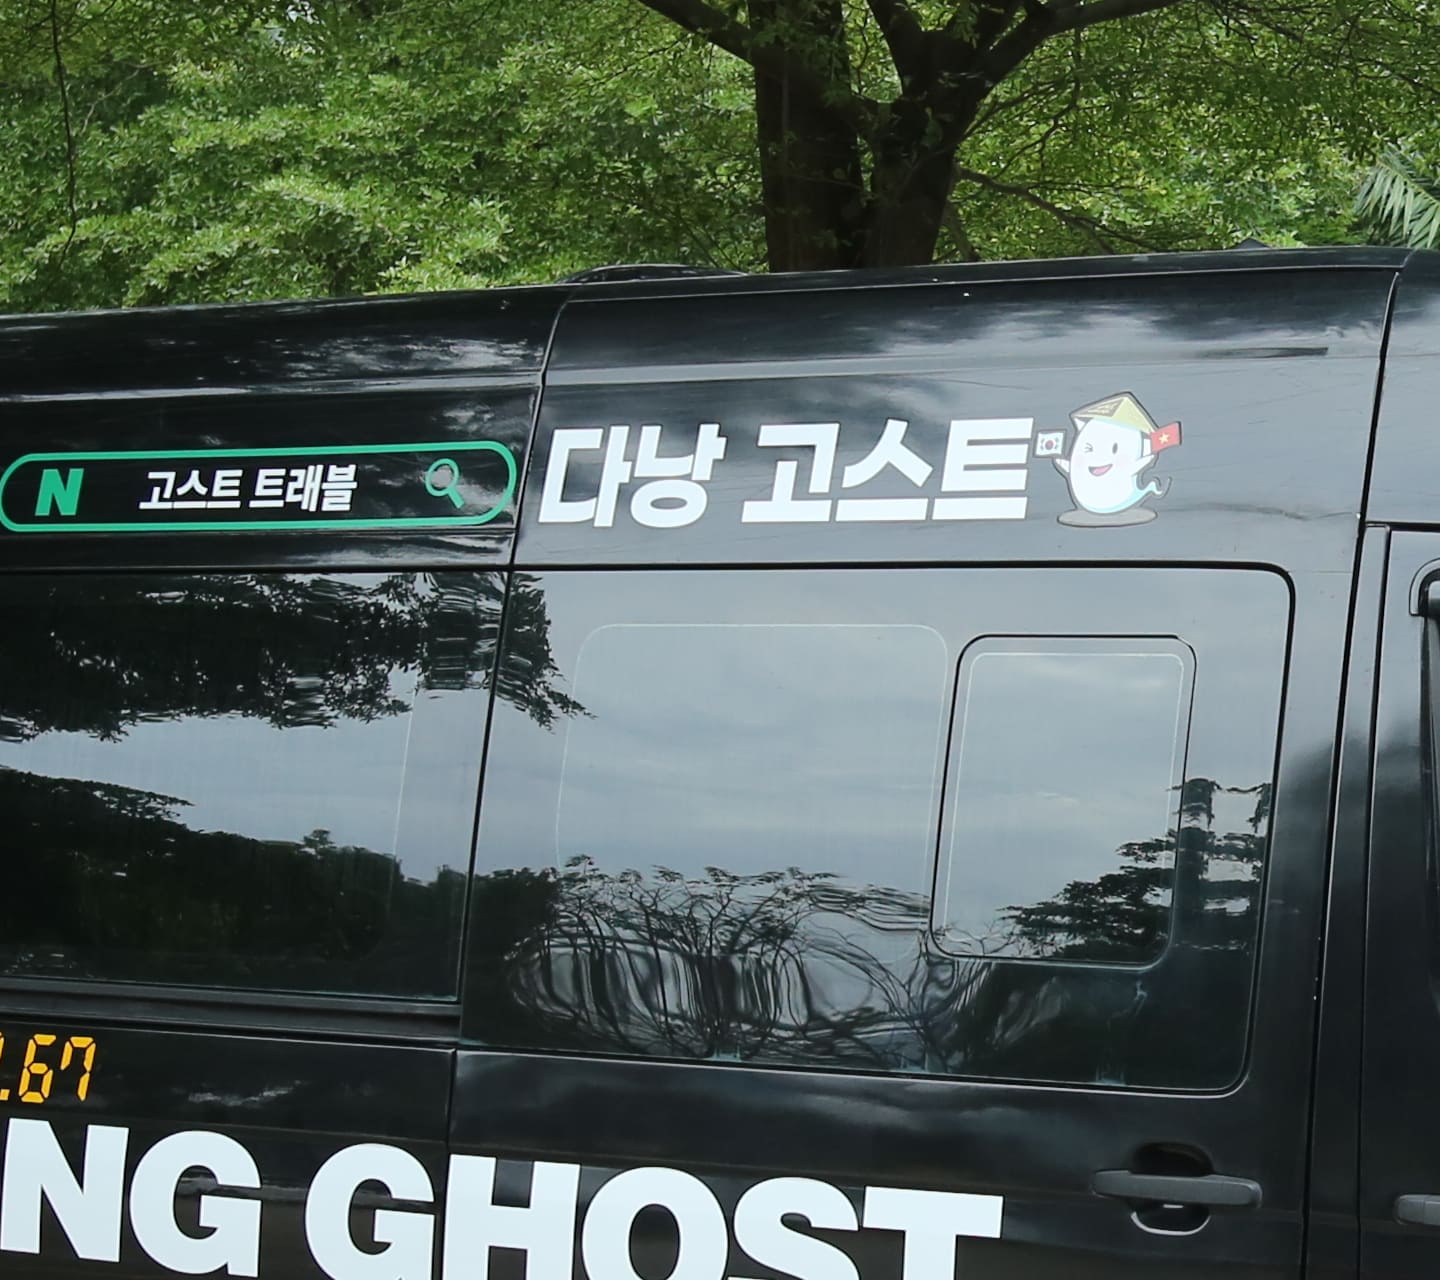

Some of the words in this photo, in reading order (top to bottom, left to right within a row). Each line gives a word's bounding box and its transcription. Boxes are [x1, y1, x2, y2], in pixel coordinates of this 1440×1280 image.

[35, 468, 84, 516] N
[138, 470, 243, 510] 고스트
[249, 464, 358, 512] 트래블
[538, 423, 728, 528] 다낭
[742, 417, 1035, 523] 고스트
